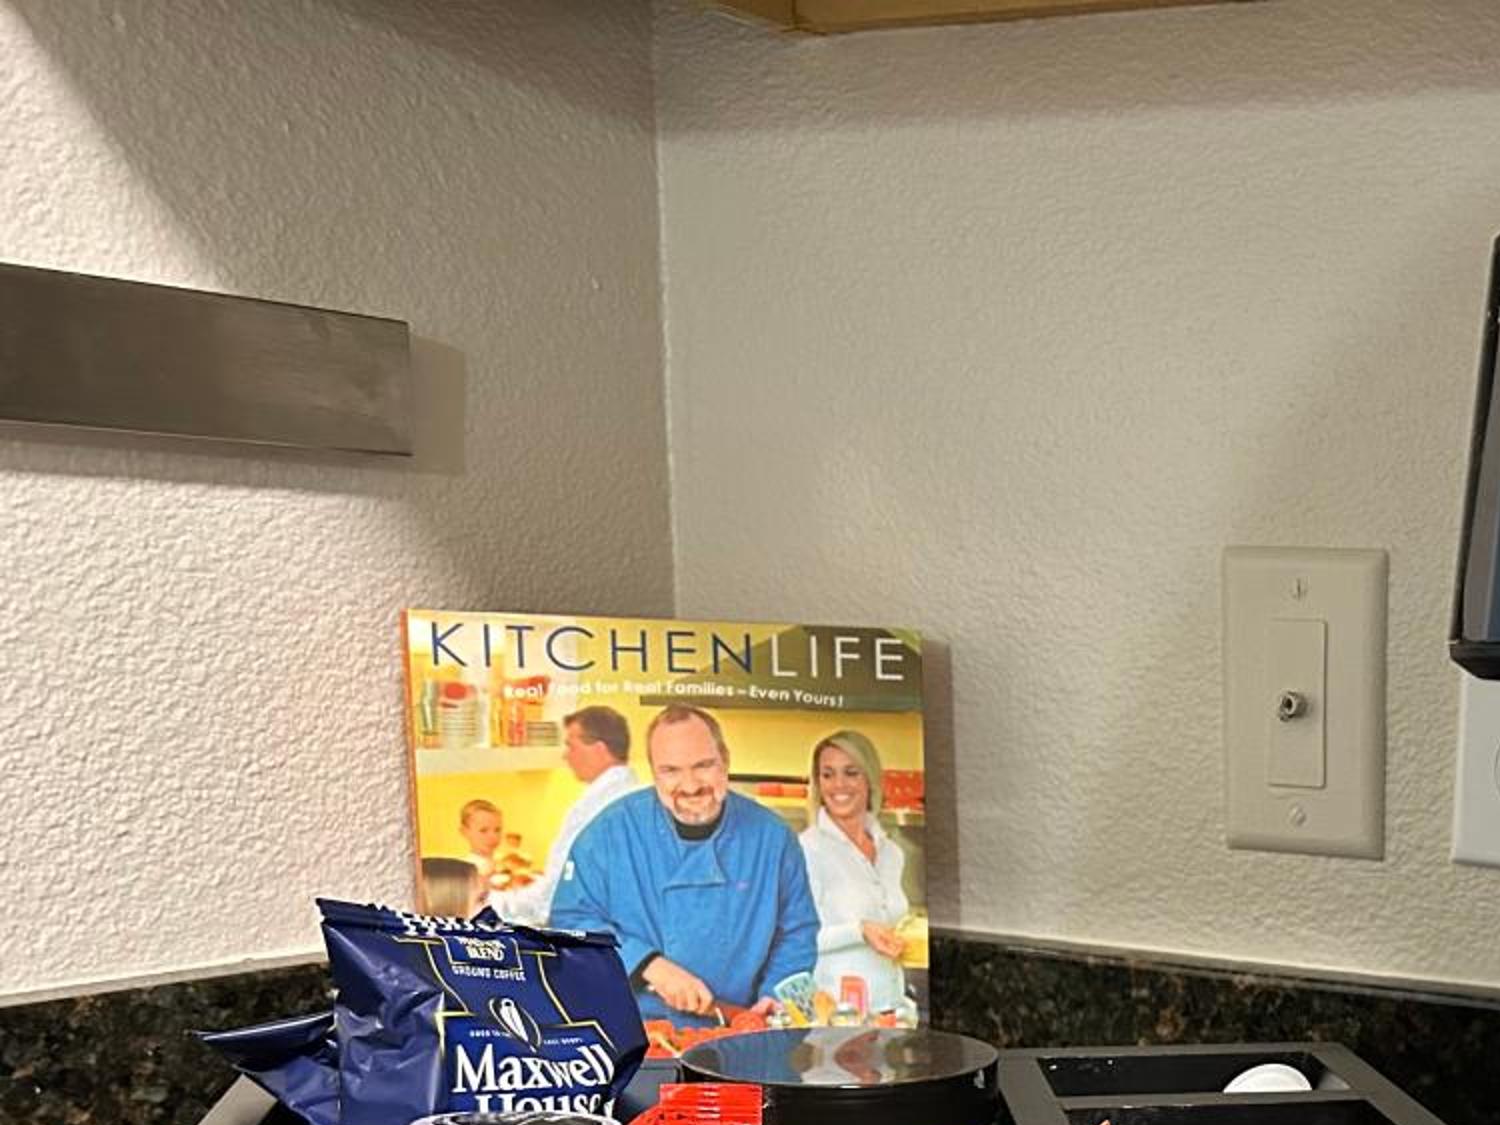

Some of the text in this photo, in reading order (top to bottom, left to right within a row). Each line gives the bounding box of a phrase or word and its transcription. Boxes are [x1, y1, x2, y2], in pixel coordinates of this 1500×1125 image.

[503, 683, 543, 699] Real
[623, 680, 661, 695] Real
[666, 680, 734, 697] Families
[749, 685, 790, 702] Even
[793, 690, 844, 708] Yours!
[452, 1043, 615, 1093] Maxwell
